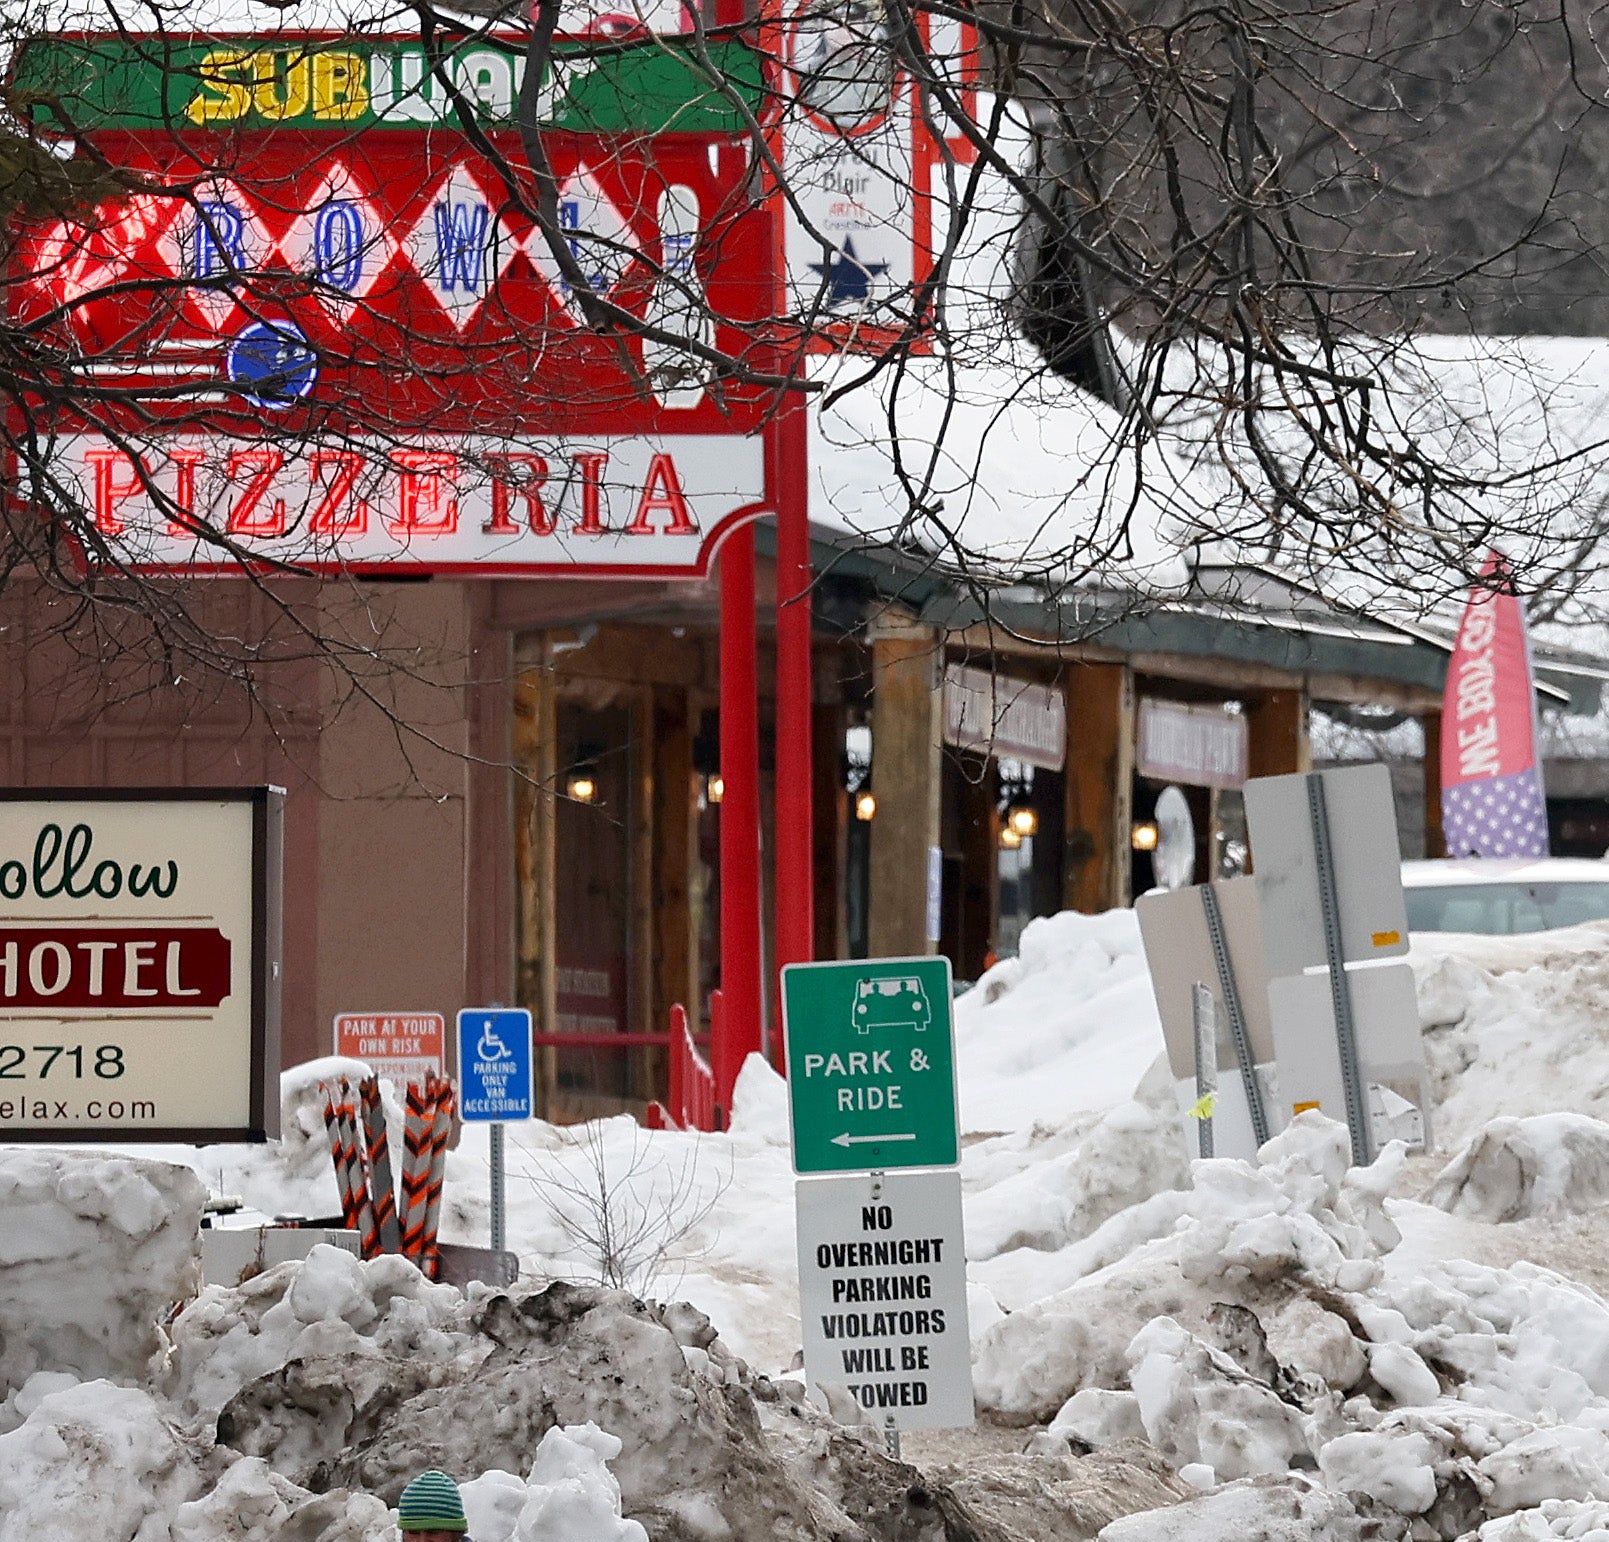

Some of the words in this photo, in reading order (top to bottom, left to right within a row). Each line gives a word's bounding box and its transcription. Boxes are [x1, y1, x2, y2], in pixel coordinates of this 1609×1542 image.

[182, 50, 599, 126] SUBWAY
[84, 452, 700, 536] PIZZERIA
[344, 1019, 376, 1035] PARK
[381, 1019, 397, 1035] AT
[402, 1019, 436, 1035] YOUR
[359, 1038, 388, 1054] OWN
[392, 1038, 421, 1053] RISK
[473, 1062, 517, 1074] PARKING
[804, 1050, 893, 1077] PARK
[909, 1048, 931, 1072] &
[481, 1076, 508, 1086] ONLY
[486, 1088, 506, 1099] VAN
[0, 1096, 156, 1119] elax.com
[464, 1099, 528, 1112] ACCESSIBLE
[837, 1086, 903, 1112] RIDE
[862, 1205, 893, 1231] NO
[816, 1238, 944, 1269] OVERNIGHT
[832, 1274, 932, 1303] PARKING
[821, 1308, 946, 1339] VIOLATORS
[841, 1347, 896, 1373] WILL
[901, 1346, 930, 1370] BE
[847, 1381, 928, 1408] TOWED
